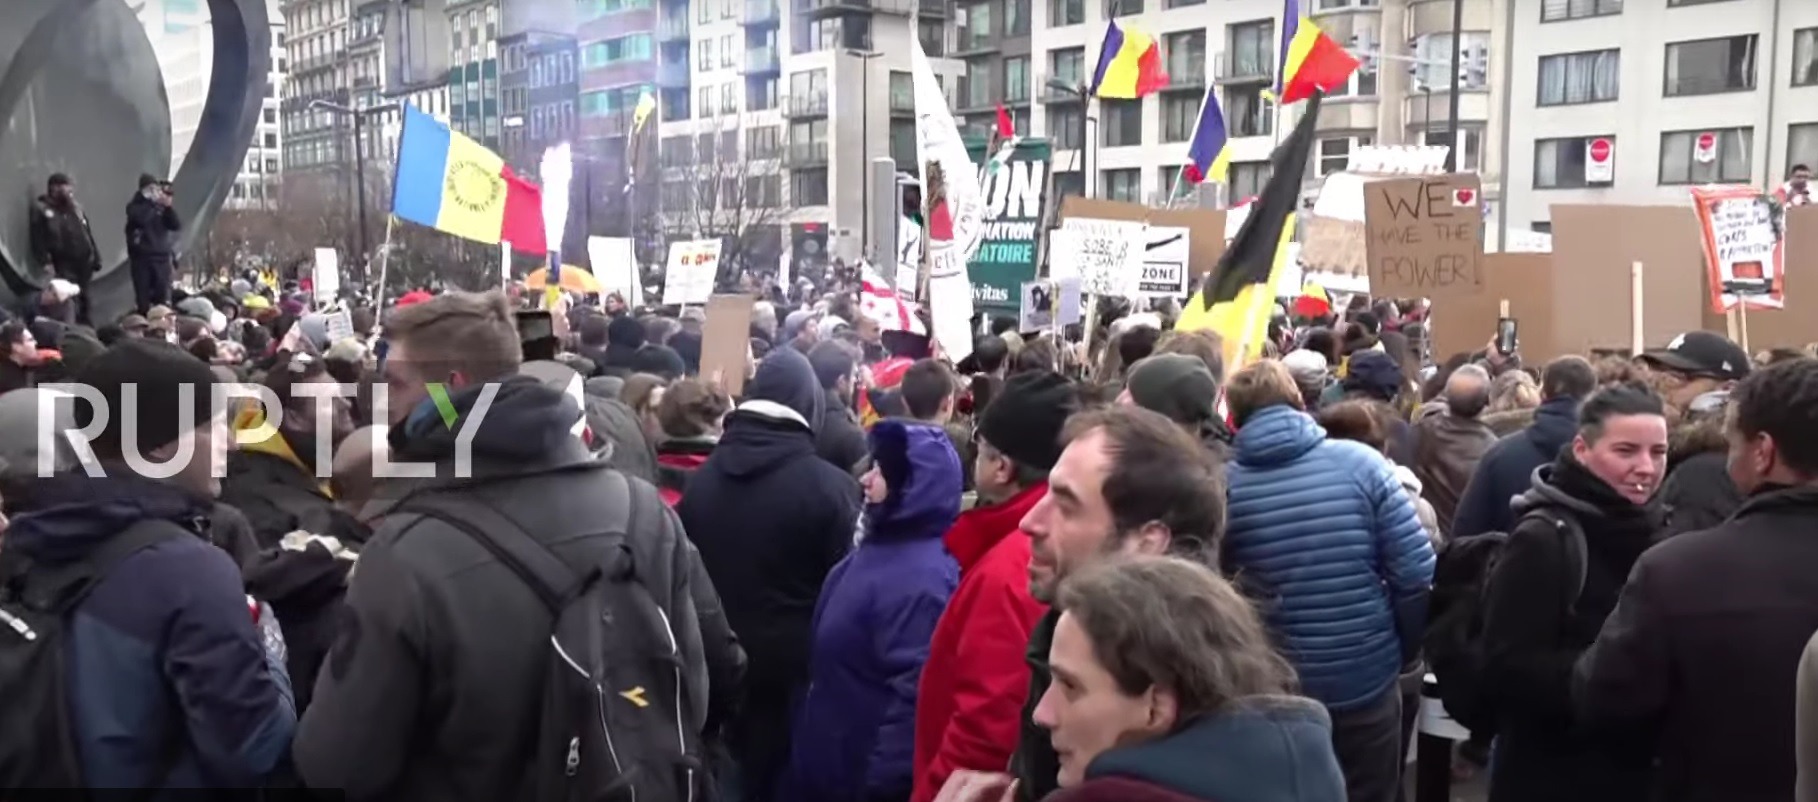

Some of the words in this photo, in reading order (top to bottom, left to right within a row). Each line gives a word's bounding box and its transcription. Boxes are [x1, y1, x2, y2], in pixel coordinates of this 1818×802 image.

[1381, 181, 1454, 221] WE
[1370, 224, 1422, 246] HAVE
[1433, 223, 1471, 242] THE
[1141, 267, 1175, 280] ZONE
[1380, 247, 1481, 289] POWER!
